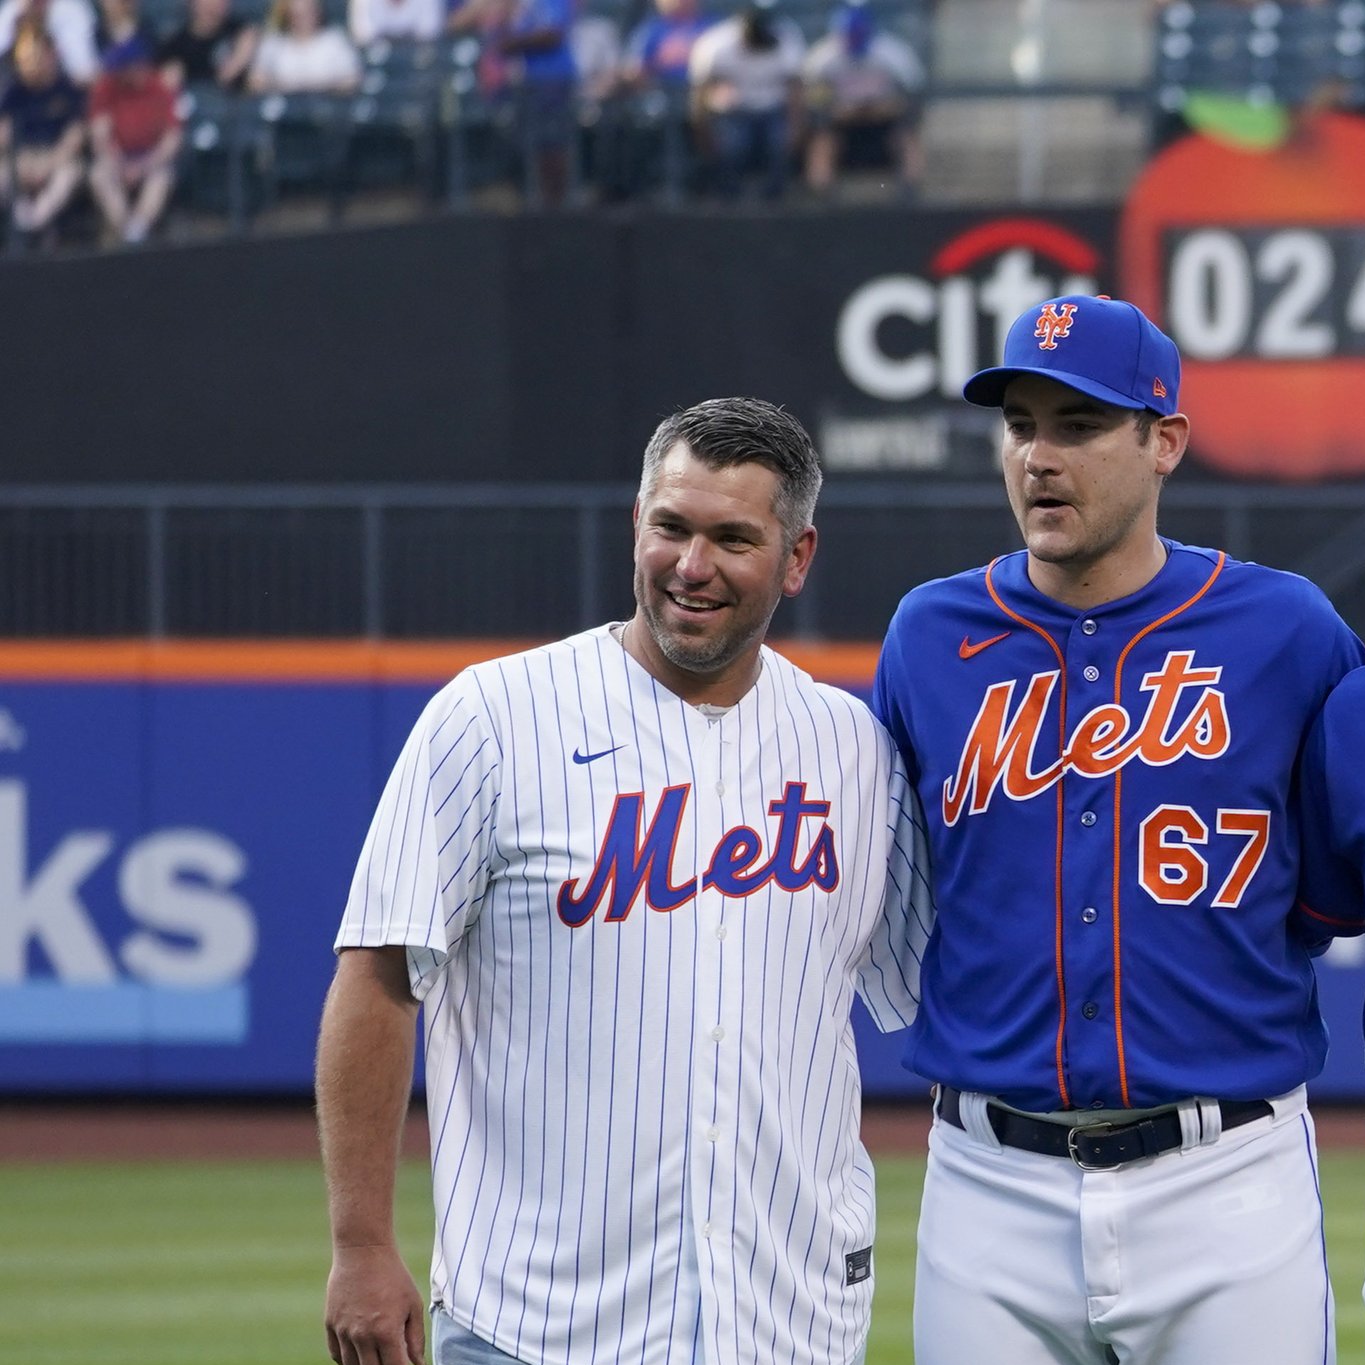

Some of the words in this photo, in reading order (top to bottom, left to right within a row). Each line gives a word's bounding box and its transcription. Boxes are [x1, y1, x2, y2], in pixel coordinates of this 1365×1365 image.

[837, 246, 1099, 401] cit
[943, 650, 1231, 827] Mets
[557, 780, 840, 928] Mets
[1139, 803, 1271, 909] 67
